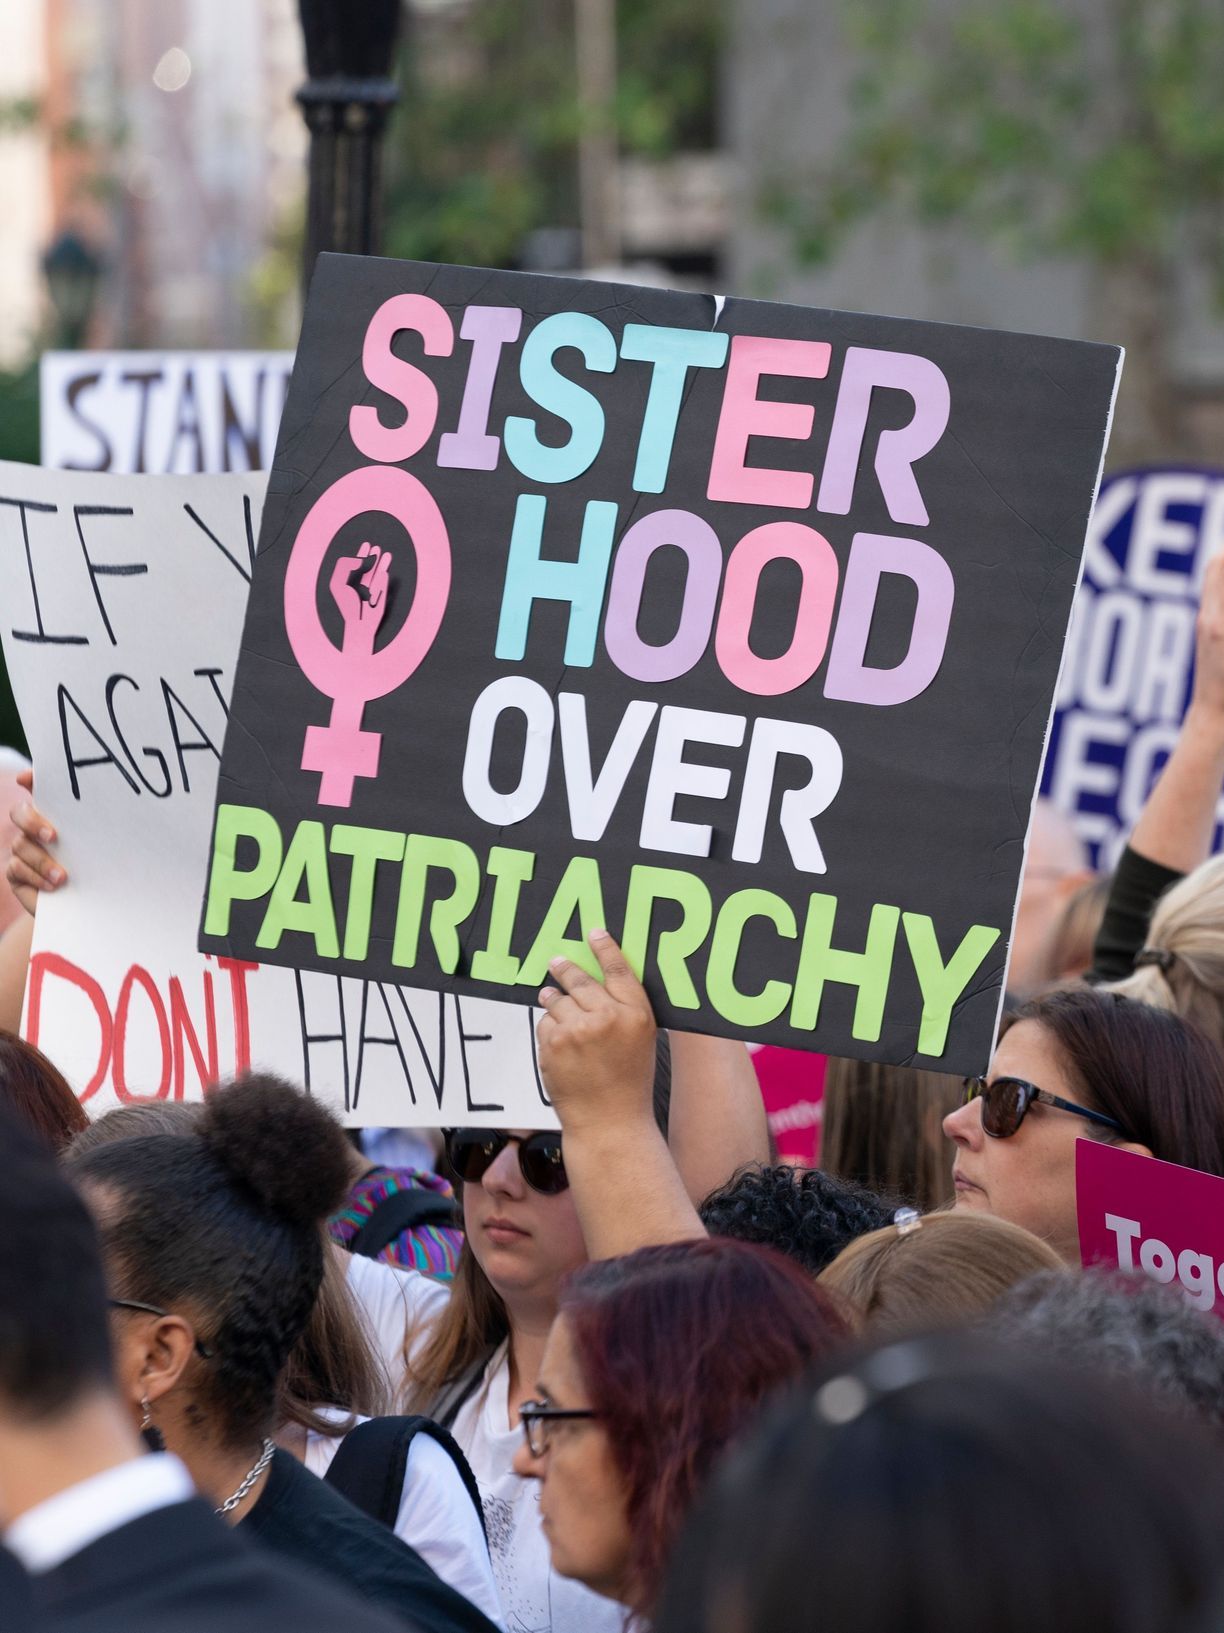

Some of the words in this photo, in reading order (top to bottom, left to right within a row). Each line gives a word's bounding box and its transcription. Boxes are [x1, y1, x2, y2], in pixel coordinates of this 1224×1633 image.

[62, 370, 292, 474] STAN
[349, 293, 951, 527] SISTER
[495, 493, 955, 707] HOOD
[462, 675, 844, 876] OVER
[203, 803, 1002, 1059] PATRIARCHY
[294, 967, 504, 1113] HAVE
